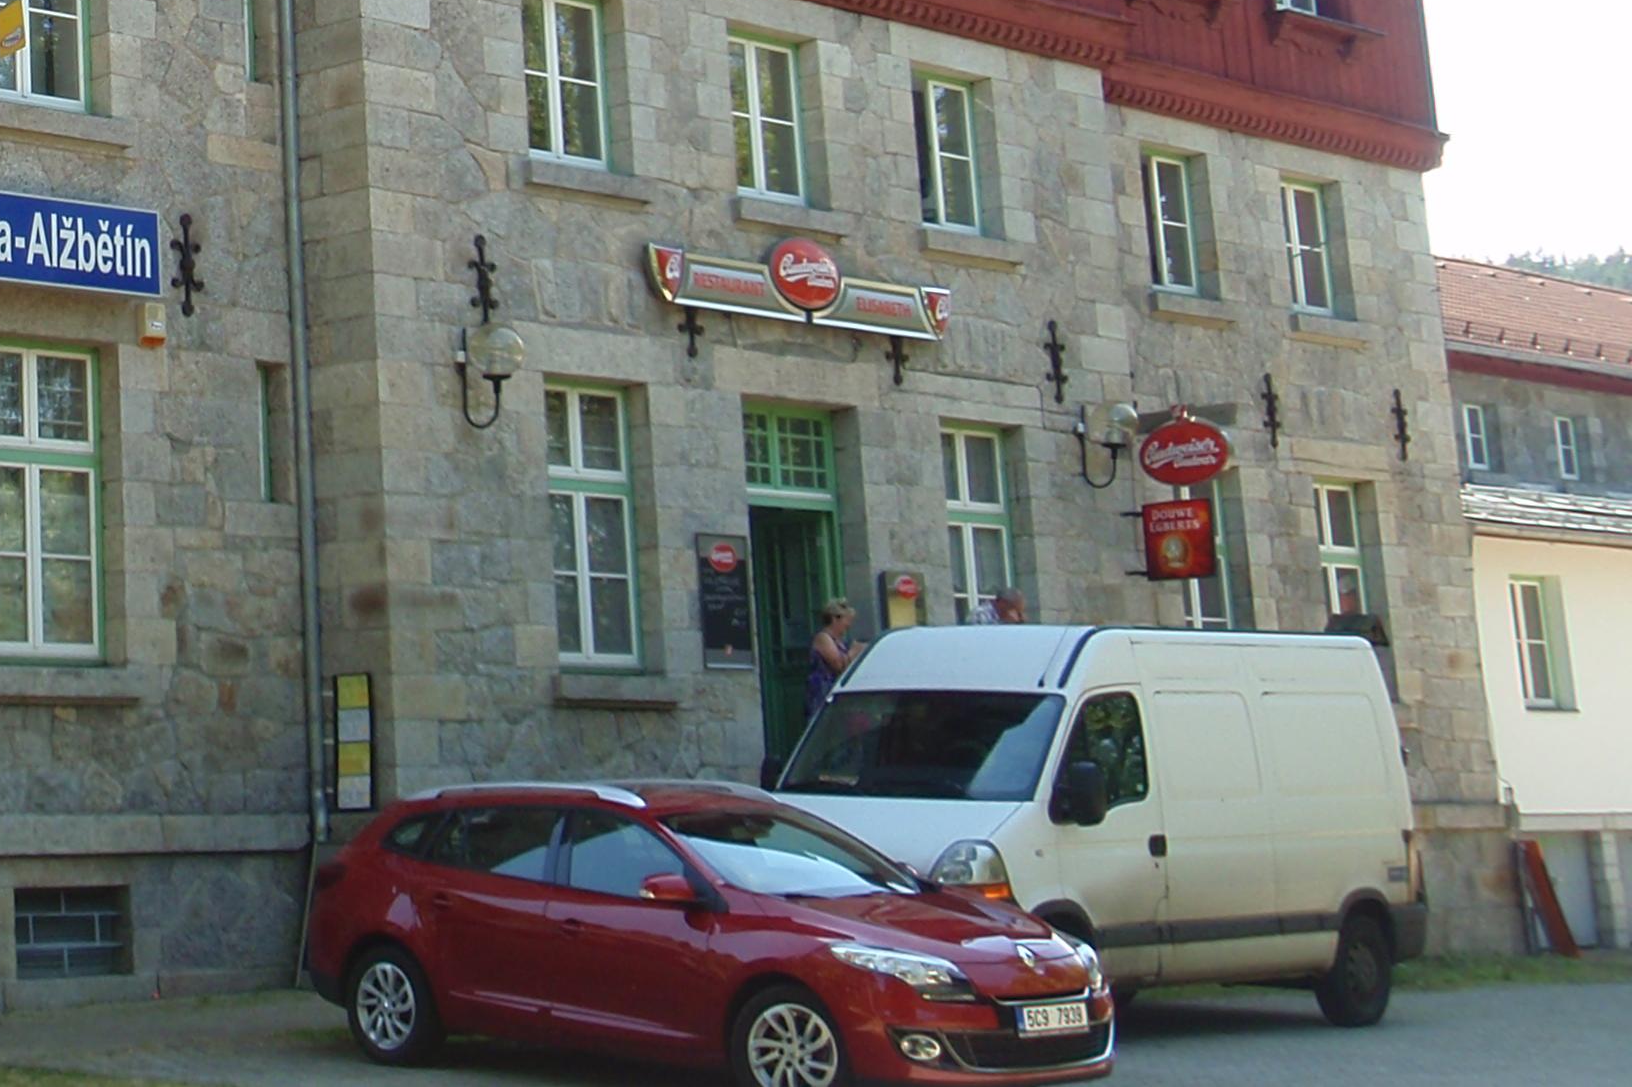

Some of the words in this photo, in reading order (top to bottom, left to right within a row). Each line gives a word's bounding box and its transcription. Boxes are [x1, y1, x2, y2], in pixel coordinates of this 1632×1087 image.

[693, 271, 765, 297] RESTAURANT
[1151, 507, 1193, 520] DOUWE
[1150, 520, 1200, 532] EGBERTS
[1027, 1008, 1049, 1027] 5C9
